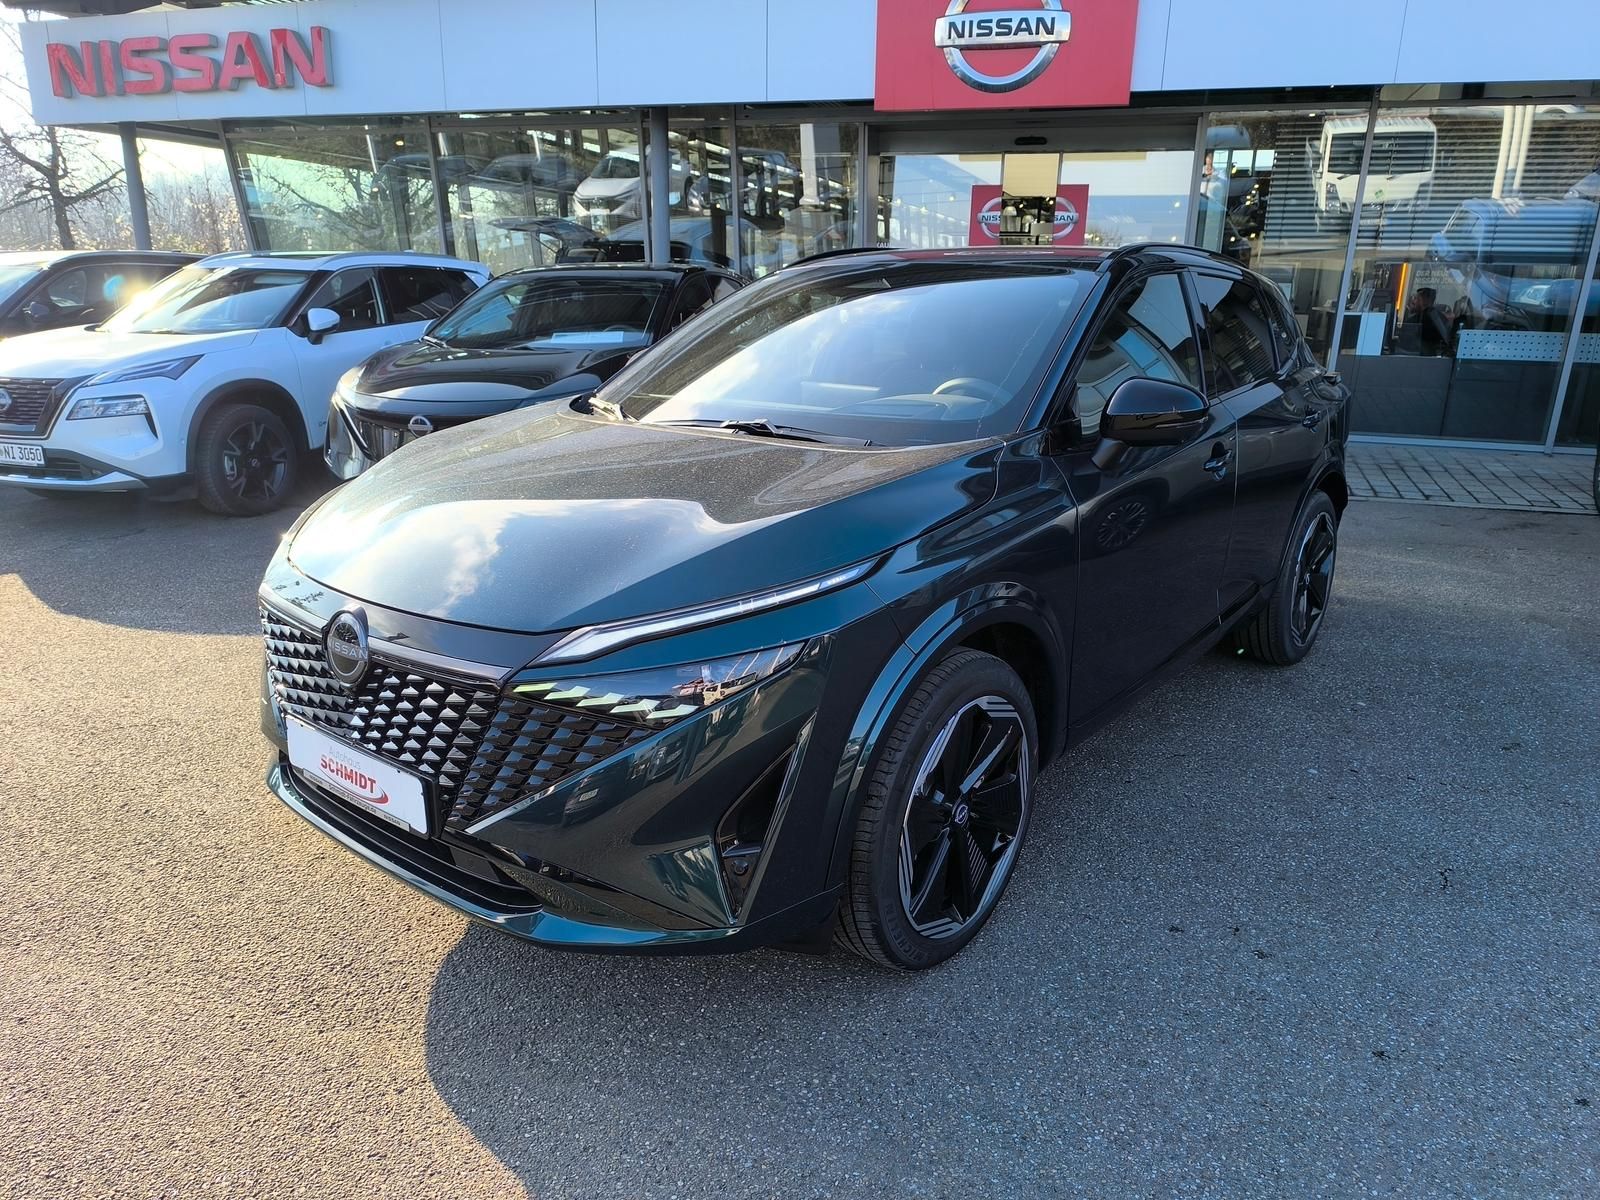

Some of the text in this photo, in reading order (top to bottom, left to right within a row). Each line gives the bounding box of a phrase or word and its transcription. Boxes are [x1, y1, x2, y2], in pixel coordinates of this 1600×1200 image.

[948, 17, 1055, 39] NISSAN
[46, 26, 333, 98] NISSAN
[3, 445, 42, 461] NI 3050
[328, 638, 368, 660] NISSAN
[320, 754, 376, 794] SCHMIDT
